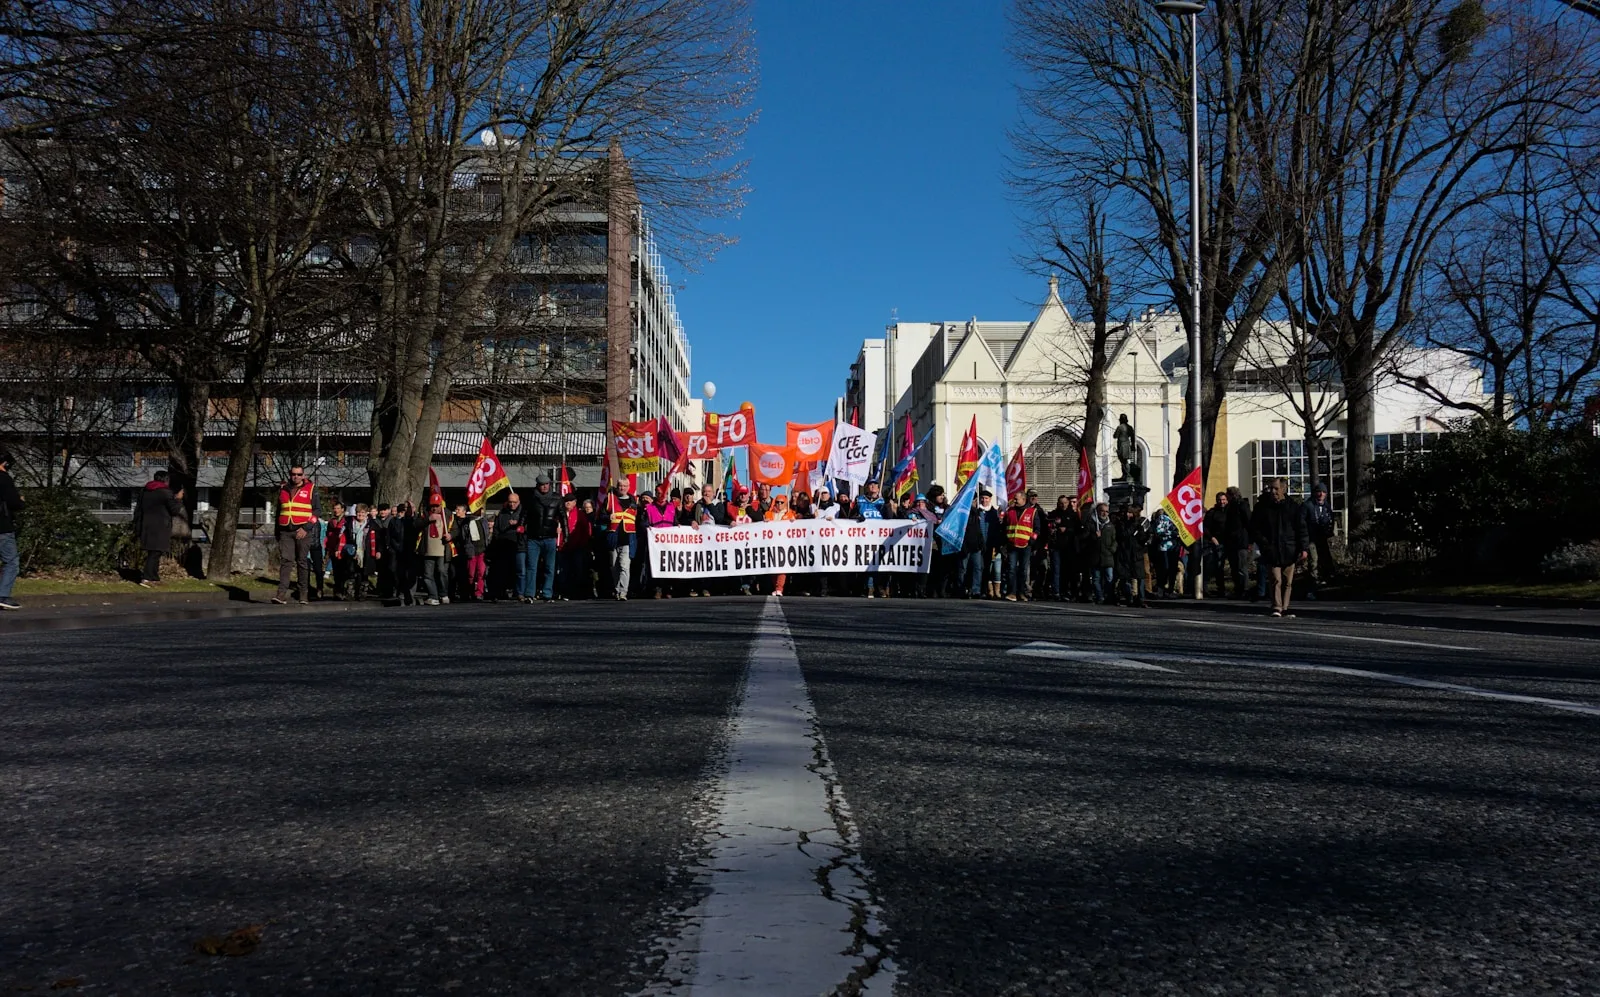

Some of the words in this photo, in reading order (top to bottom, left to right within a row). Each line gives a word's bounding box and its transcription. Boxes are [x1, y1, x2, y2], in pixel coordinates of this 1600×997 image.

[717, 413, 747, 444] FO
[614, 431, 654, 459] cgt
[687, 434, 708, 456] FO
[838, 435, 861, 449] CFE
[846, 445, 869, 460] CGC
[655, 533, 703, 544] SOLIDAIRES
[715, 531, 750, 543] CFE-CGC
[762, 529, 774, 540] FO
[786, 528, 807, 538] CFDT
[819, 527, 836, 538] CGT
[847, 527, 866, 537] CFTC
[878, 527, 894, 537] FSU
[907, 527, 929, 538] UNSA
[660, 549, 728, 573] ENSEMBLE
[734, 542, 815, 570] DÉFENDONS
[821, 544, 848, 566] NOS
[855, 544, 924, 567] RETRAITES
